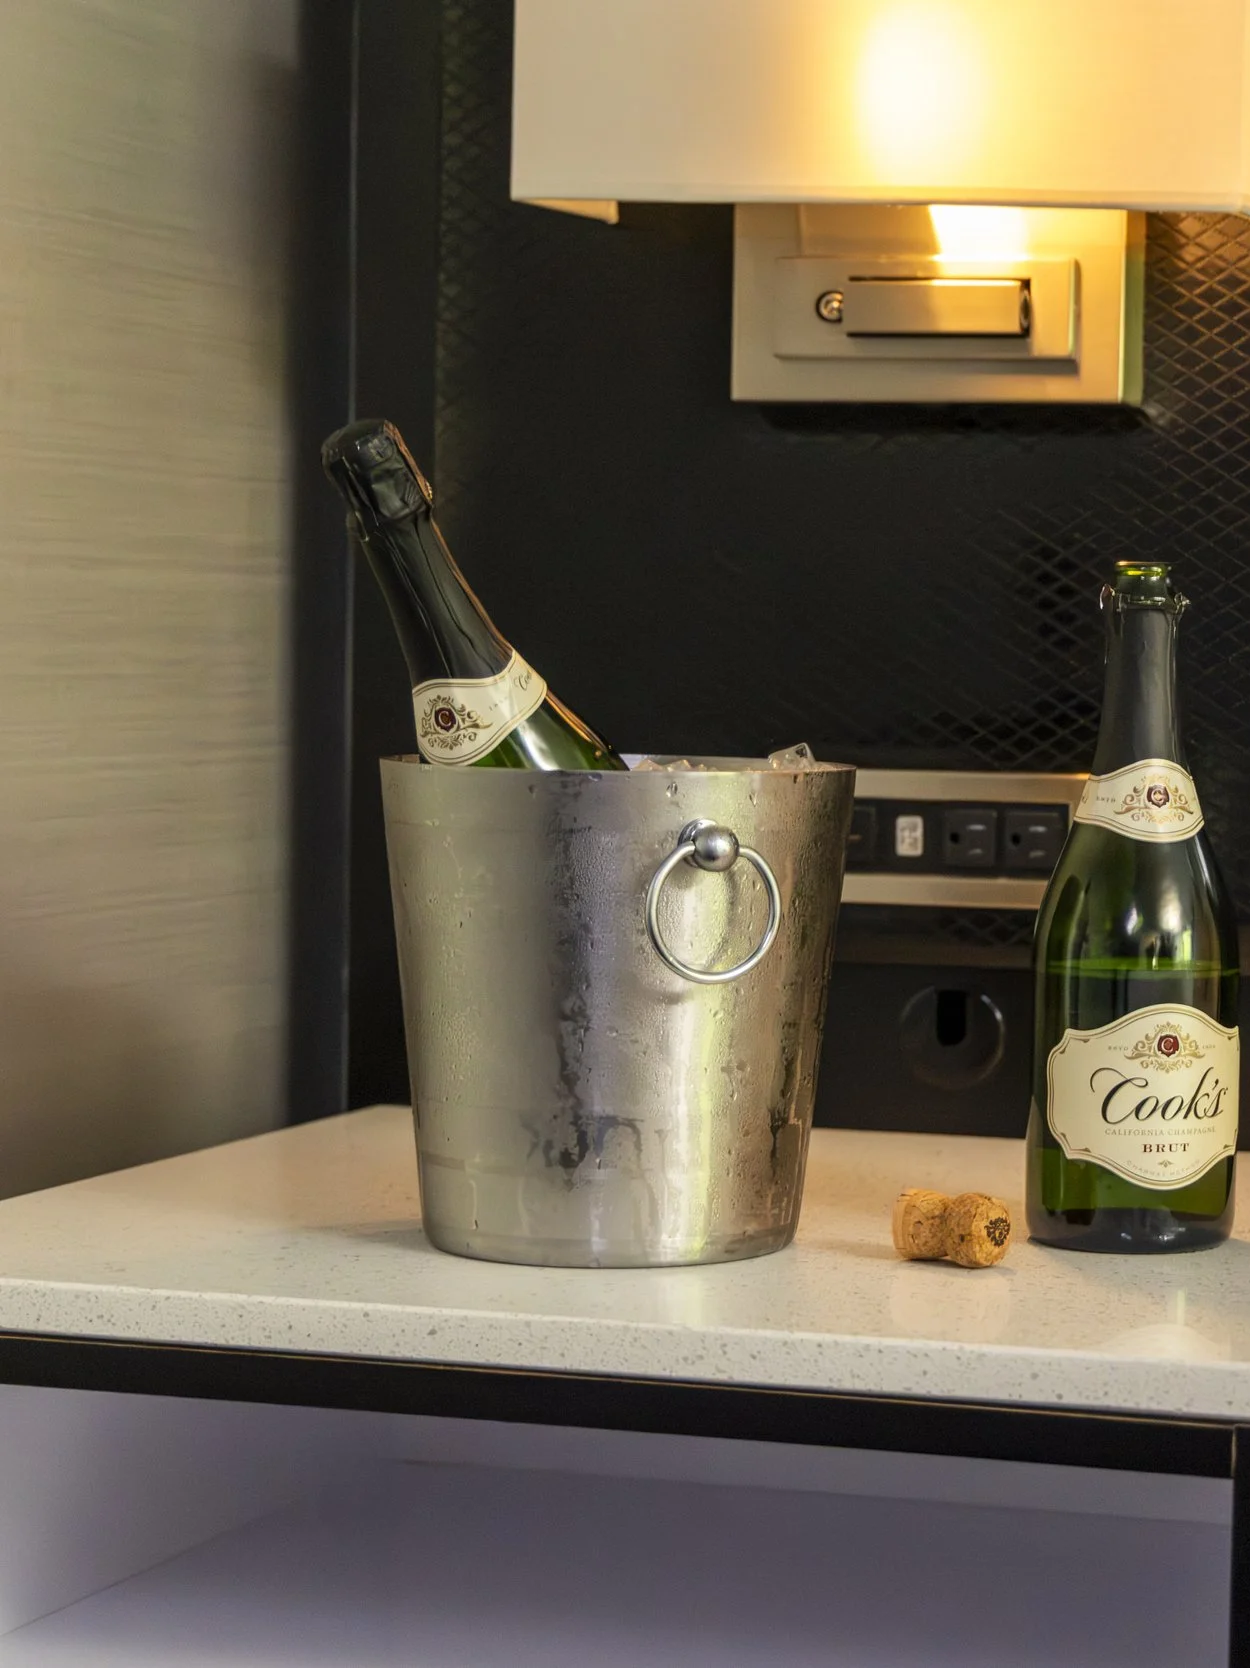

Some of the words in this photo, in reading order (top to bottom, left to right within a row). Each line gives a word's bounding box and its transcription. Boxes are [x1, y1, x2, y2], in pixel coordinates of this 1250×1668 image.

[1090, 1067, 1228, 1125] Cook's
[1104, 1127, 1165, 1136] CALIFORNIA
[1167, 1126, 1216, 1136] CHAMPAGNE
[1142, 1142, 1190, 1153] BRUT
